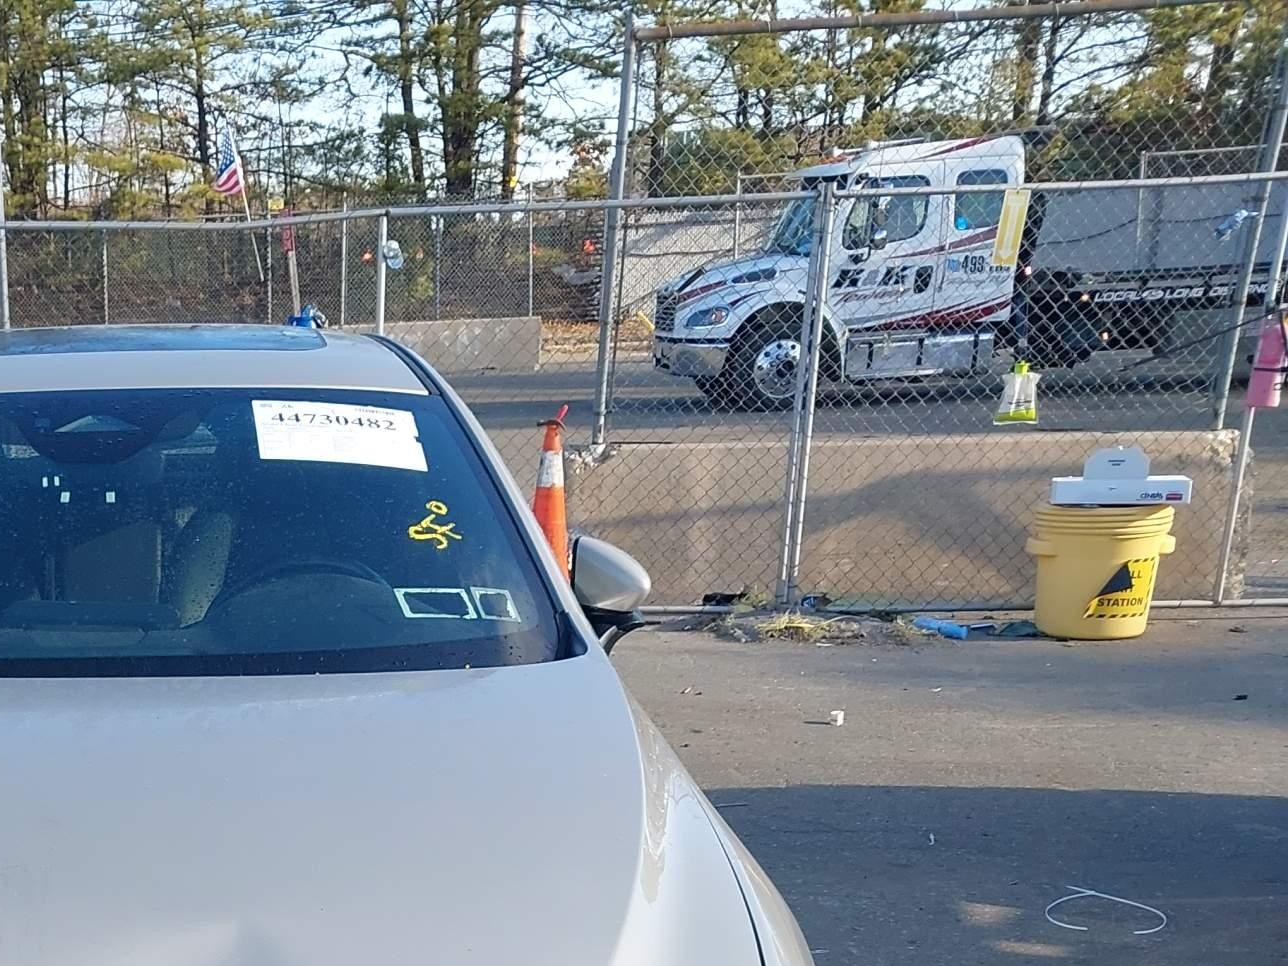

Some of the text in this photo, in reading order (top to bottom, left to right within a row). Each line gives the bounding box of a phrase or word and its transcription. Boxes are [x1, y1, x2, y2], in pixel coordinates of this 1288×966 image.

[1165, 287, 1205, 299] LONG
[271, 412, 397, 431] 44730482
[1097, 597, 1144, 607] STATION
